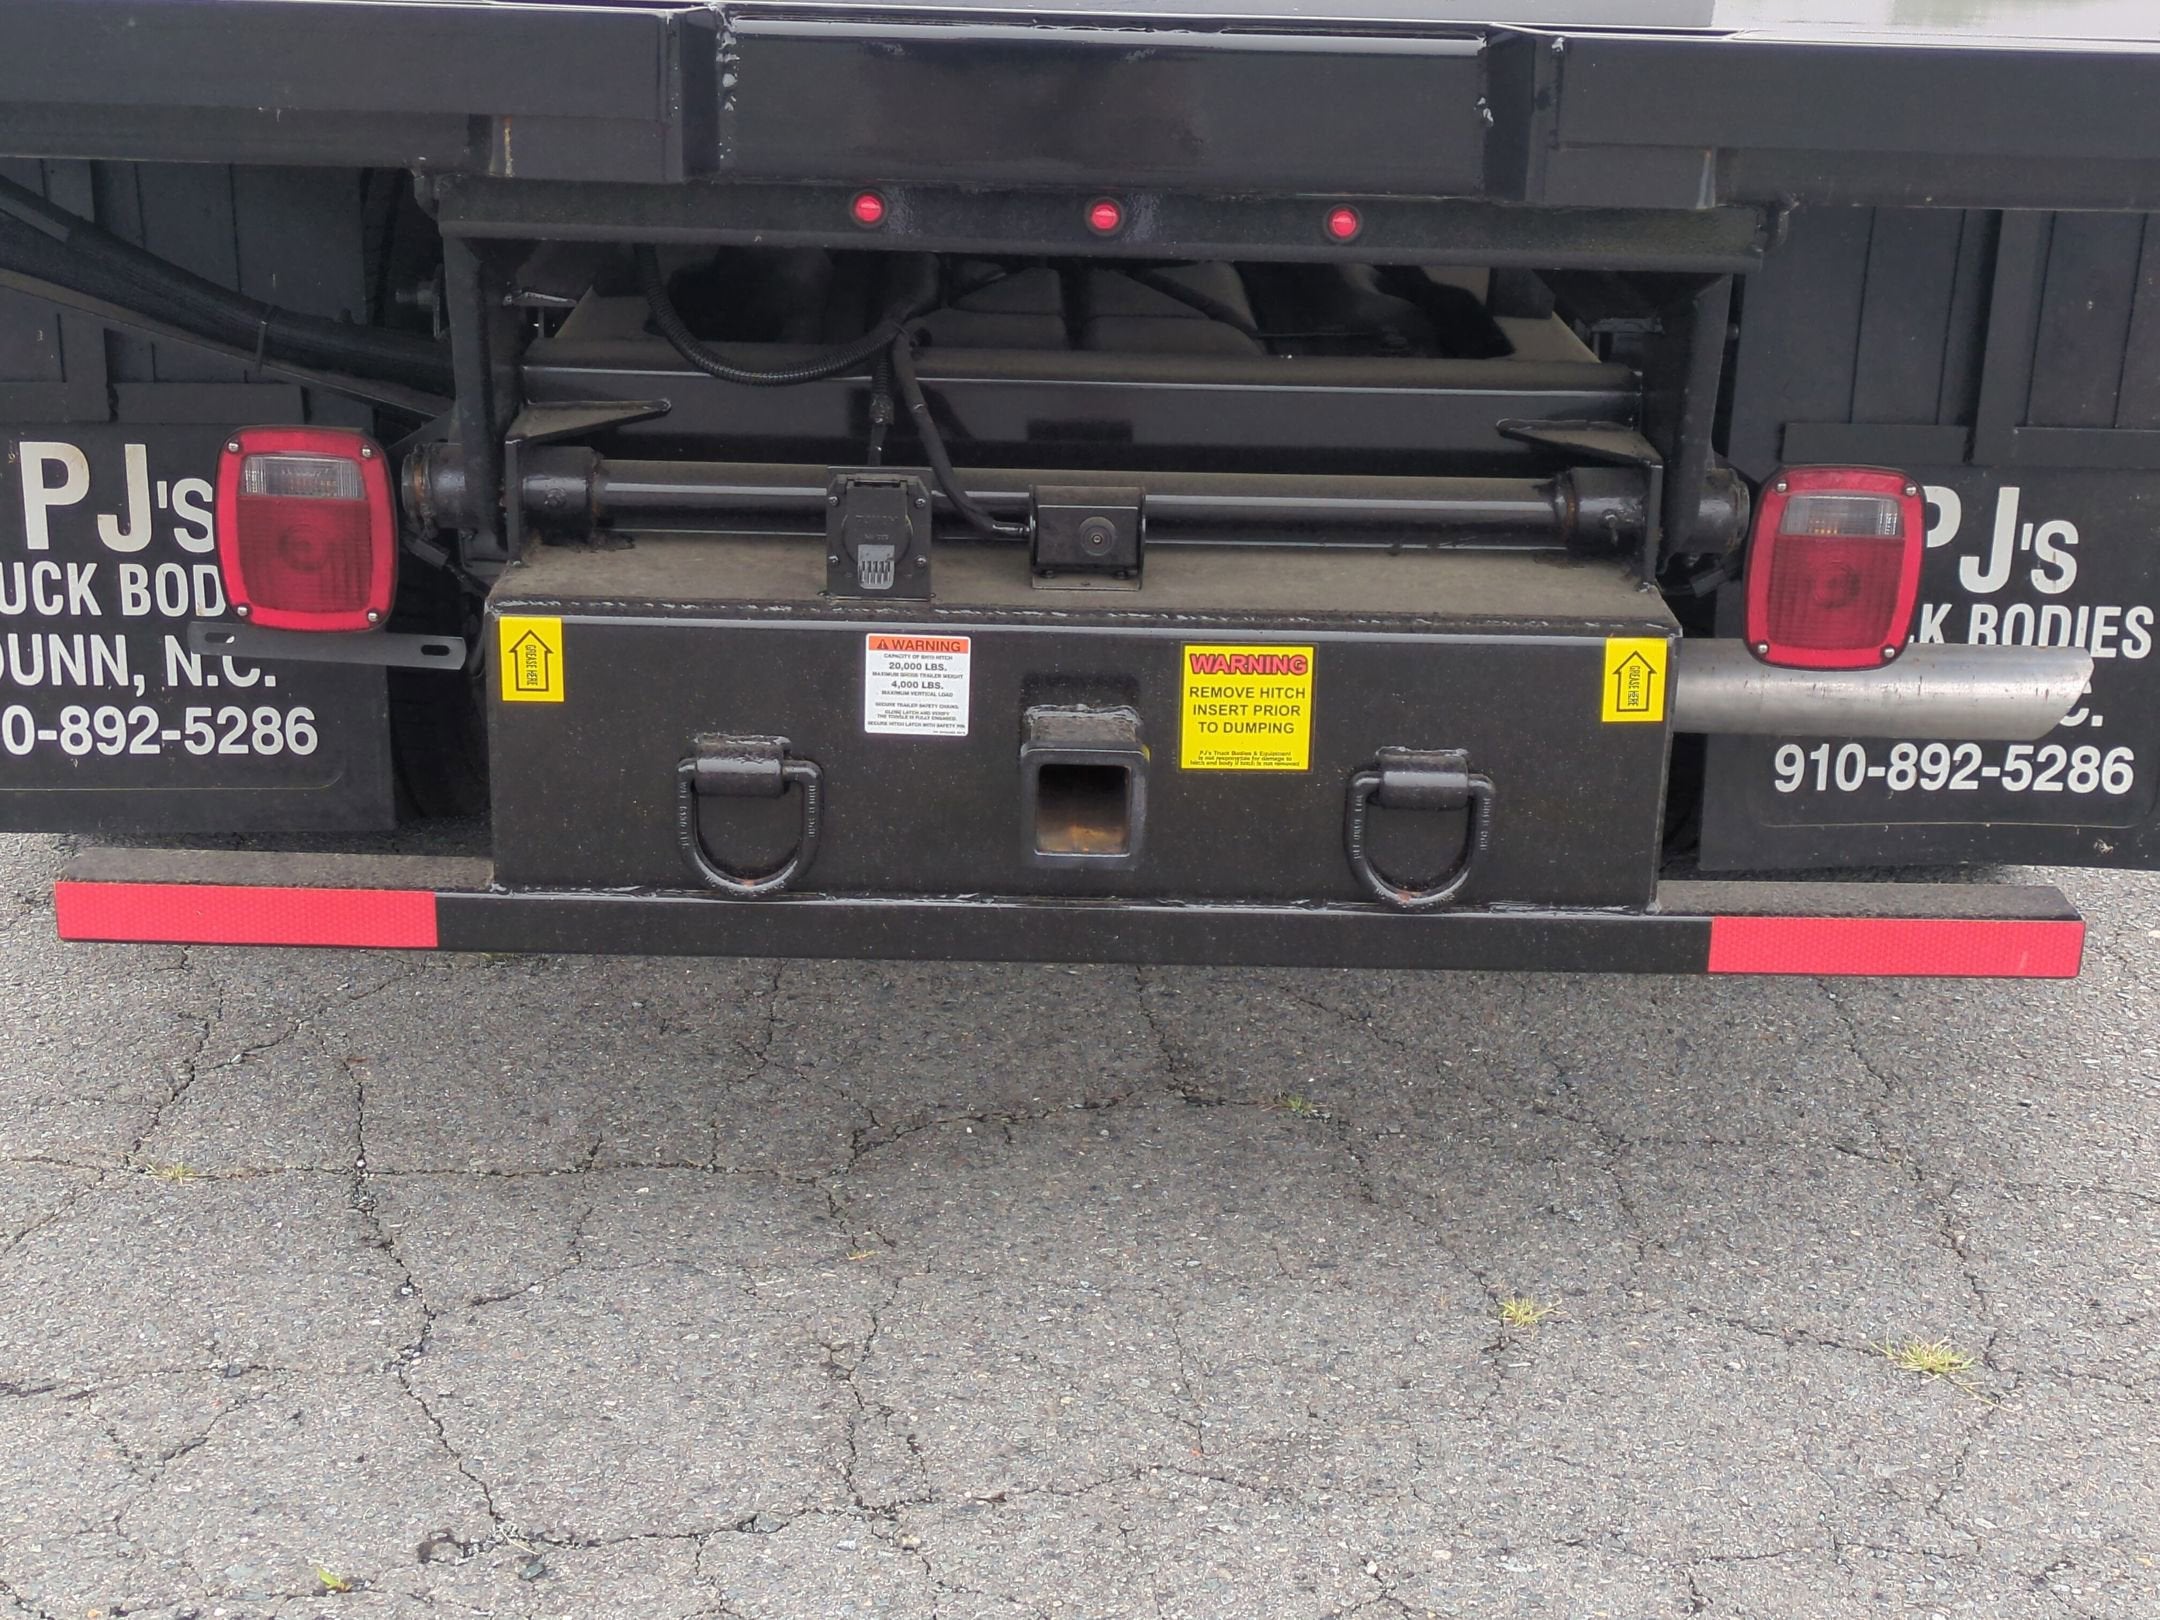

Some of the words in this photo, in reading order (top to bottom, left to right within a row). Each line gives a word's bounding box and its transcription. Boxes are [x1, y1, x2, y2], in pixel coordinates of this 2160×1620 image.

[0, 561, 102, 616] UCK
[119, 563, 227, 617] BOD
[892, 639, 961, 652] WARNING
[0, 633, 145, 697] UNN,
[889, 662, 922, 671] 20,000
[925, 663, 947, 671] LBS.
[1189, 653, 1308, 675] WARNING
[891, 681, 918, 689] 4,000
[922, 681, 944, 689] LBS.
[1189, 687, 1255, 698] REMOVE
[1260, 687, 1306, 699] HITCH
[1193, 704, 1248, 716] INSERT
[1253, 705, 1301, 716] PRIOR
[2, 705, 318, 755] 0-892-5286
[1198, 722, 1218, 733] TO
[1223, 722, 1294, 734] DUMPING
[1774, 743, 2134, 794] 910-892-5286
